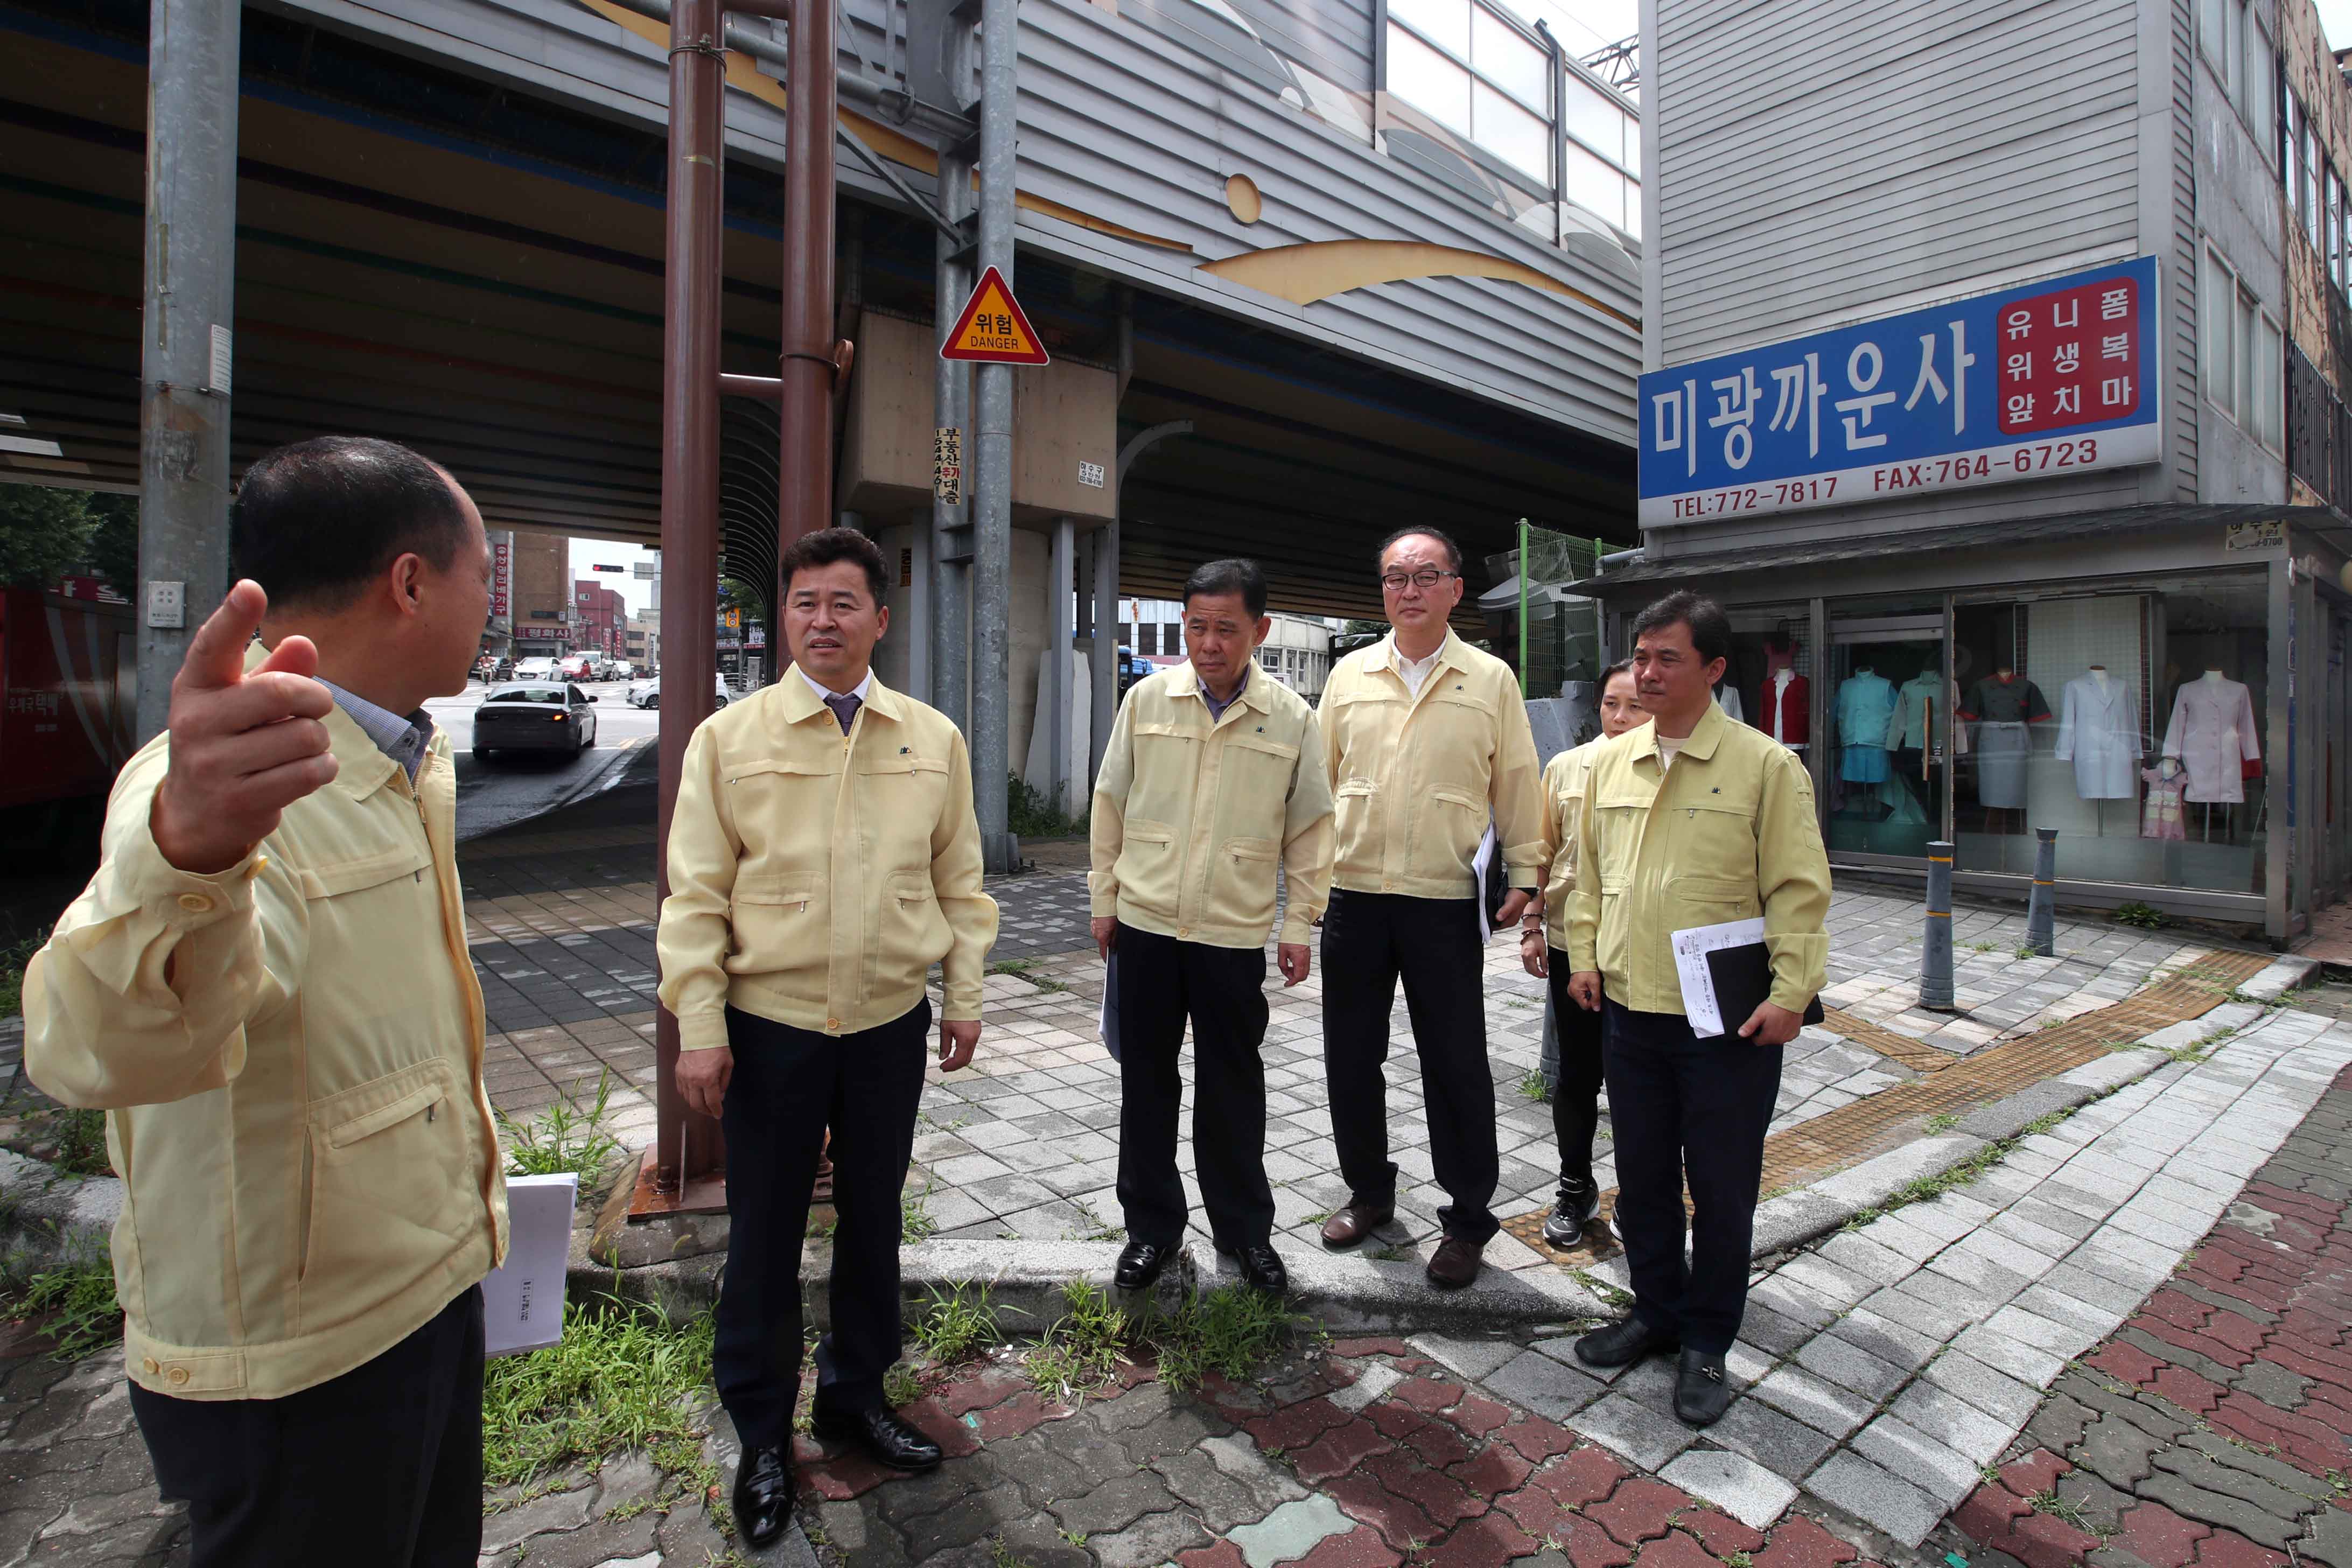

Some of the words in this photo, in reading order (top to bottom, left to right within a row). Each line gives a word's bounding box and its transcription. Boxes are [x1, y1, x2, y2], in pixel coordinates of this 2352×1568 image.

[975, 313, 1011, 335] 위험
[2007, 288, 2129, 340] 유니폼
[971, 336, 1018, 349] DANGER
[2007, 332, 2129, 381] 위생복
[1652, 320, 1975, 478] 미광까운사
[2007, 376, 2132, 425] 앞치마
[943, 428, 960, 466] 부동산
[1081, 463, 1102, 474] 하수구
[1672, 477, 1838, 518] TEL:772-7817
[1874, 439, 2097, 492] FAX:764-6723
[943, 479, 959, 504] 대출
[529, 628, 569, 639] 평화사
